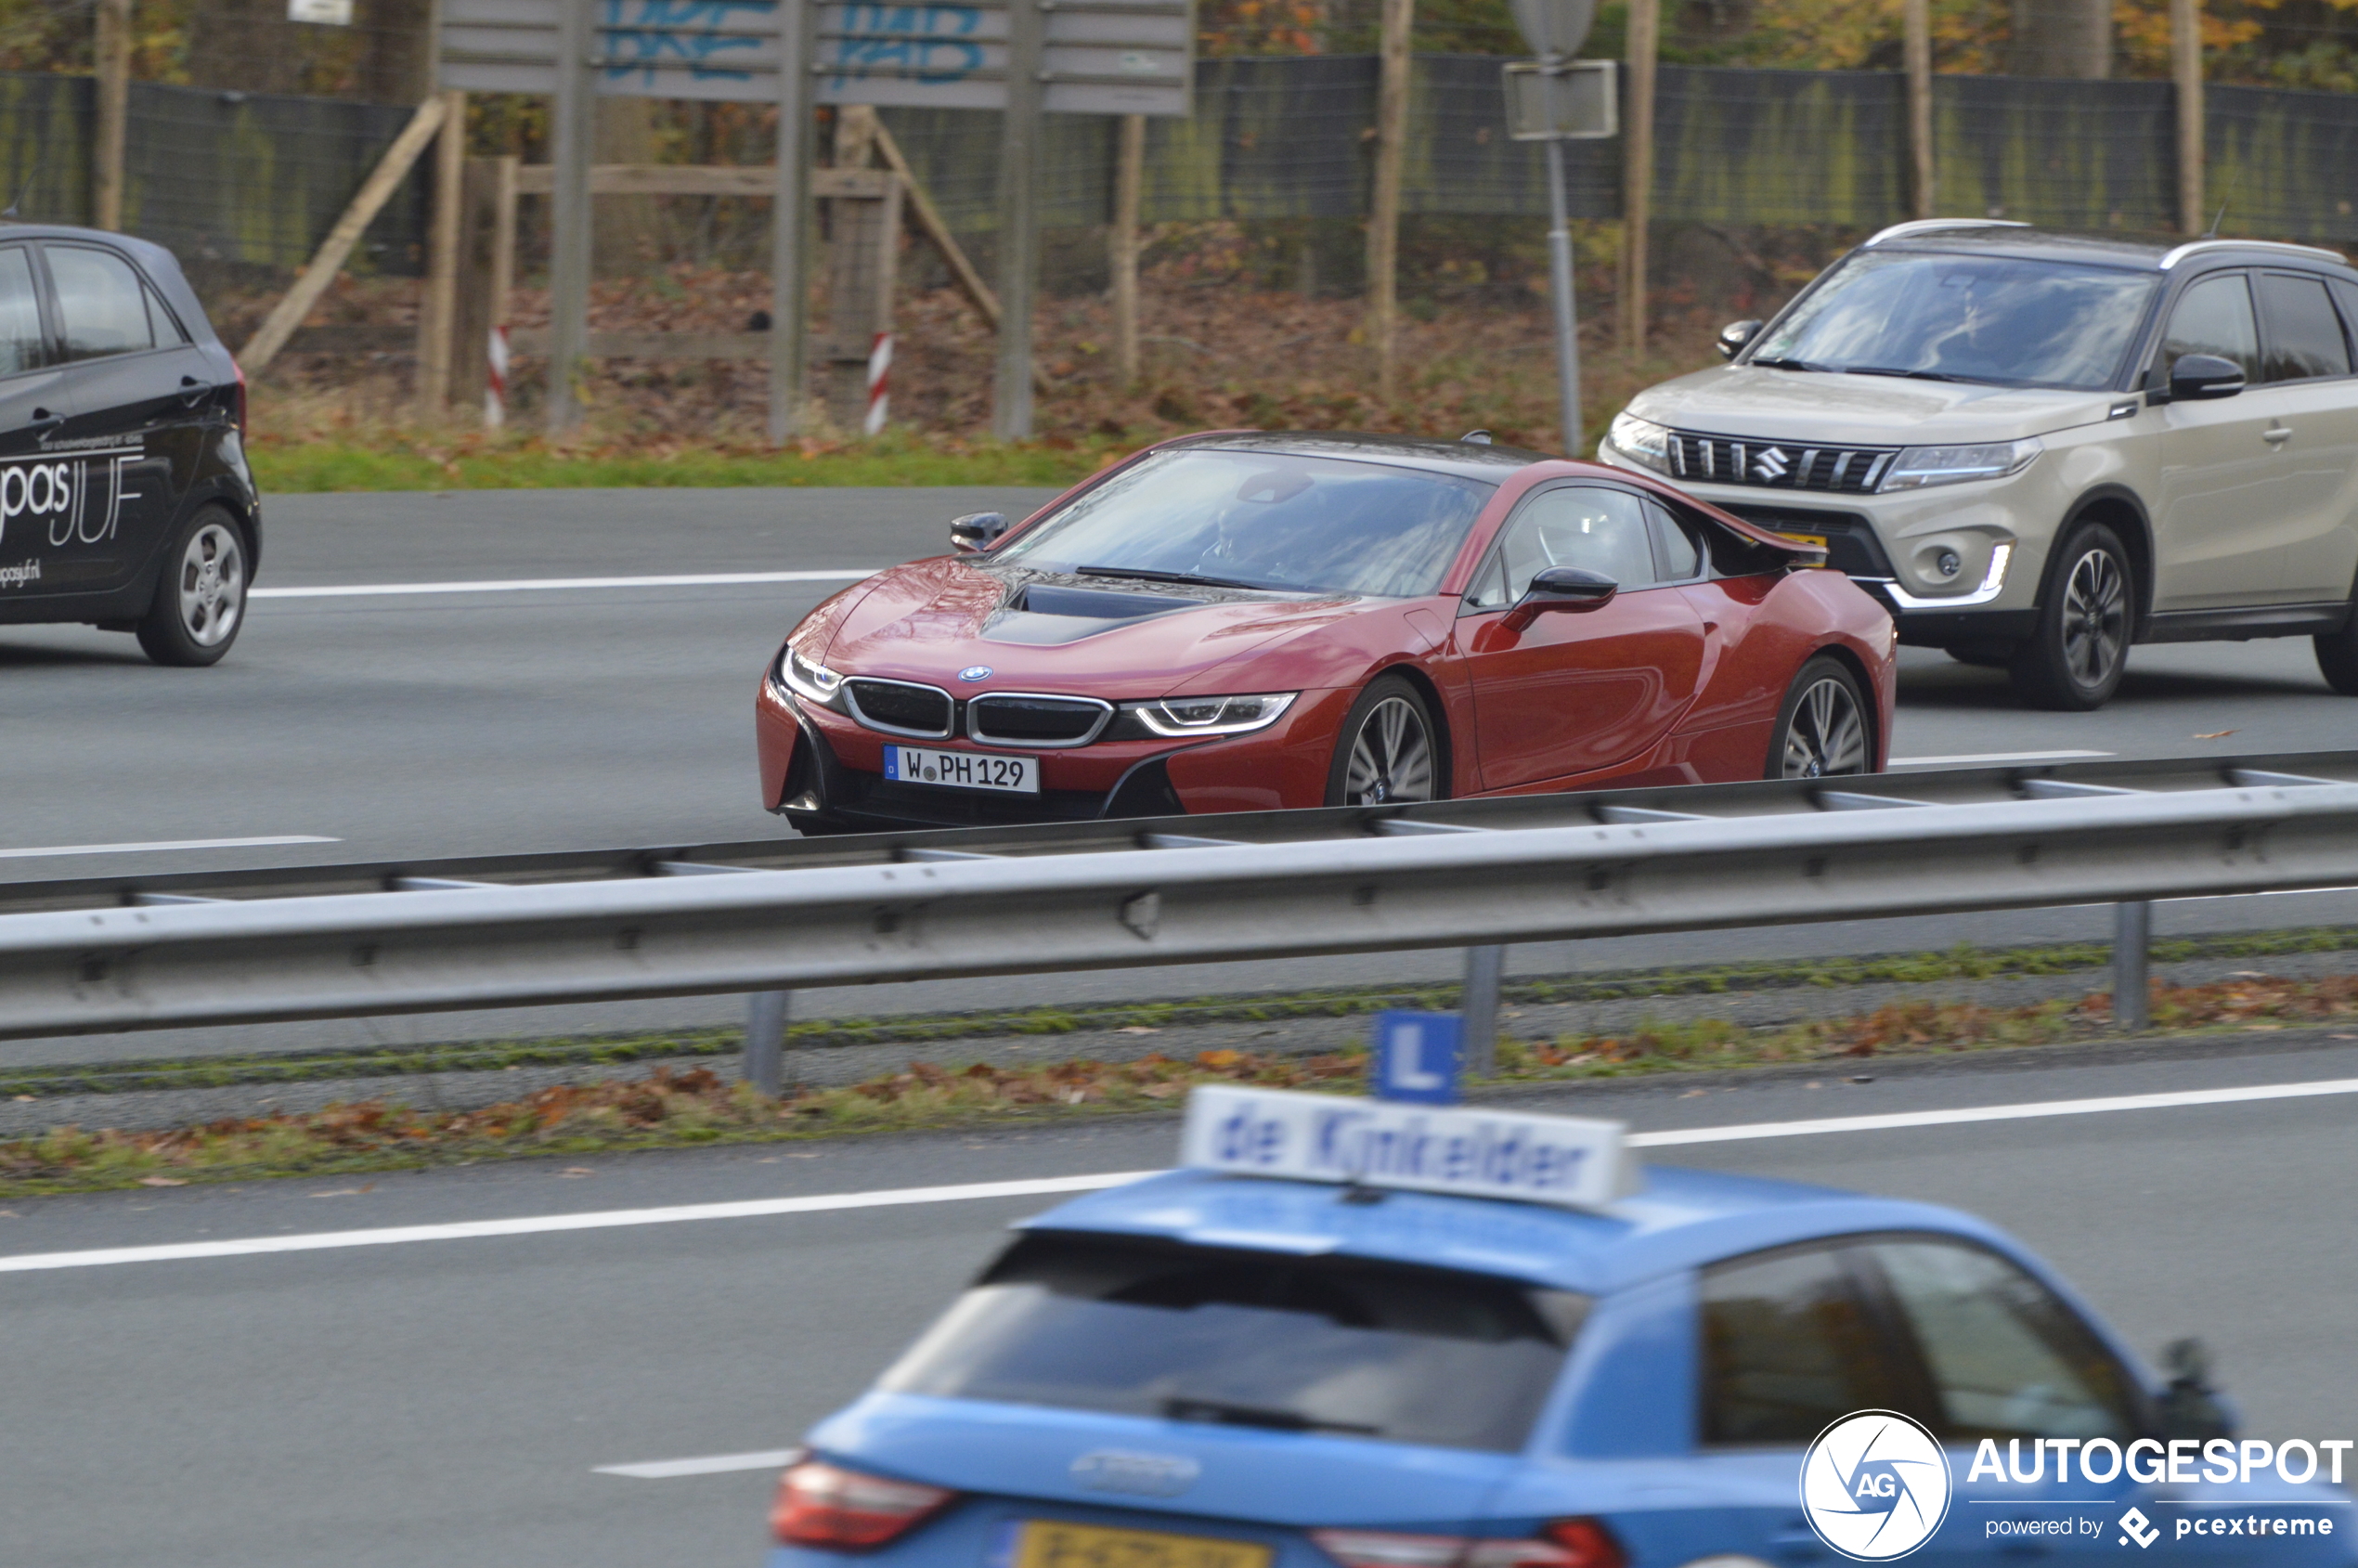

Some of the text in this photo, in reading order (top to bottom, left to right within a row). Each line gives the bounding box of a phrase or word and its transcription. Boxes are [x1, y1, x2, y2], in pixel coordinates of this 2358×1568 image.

[906, 751, 1024, 787] W PH 129
[1391, 1024, 1444, 1090] L
[1211, 1103, 1287, 1164] de
